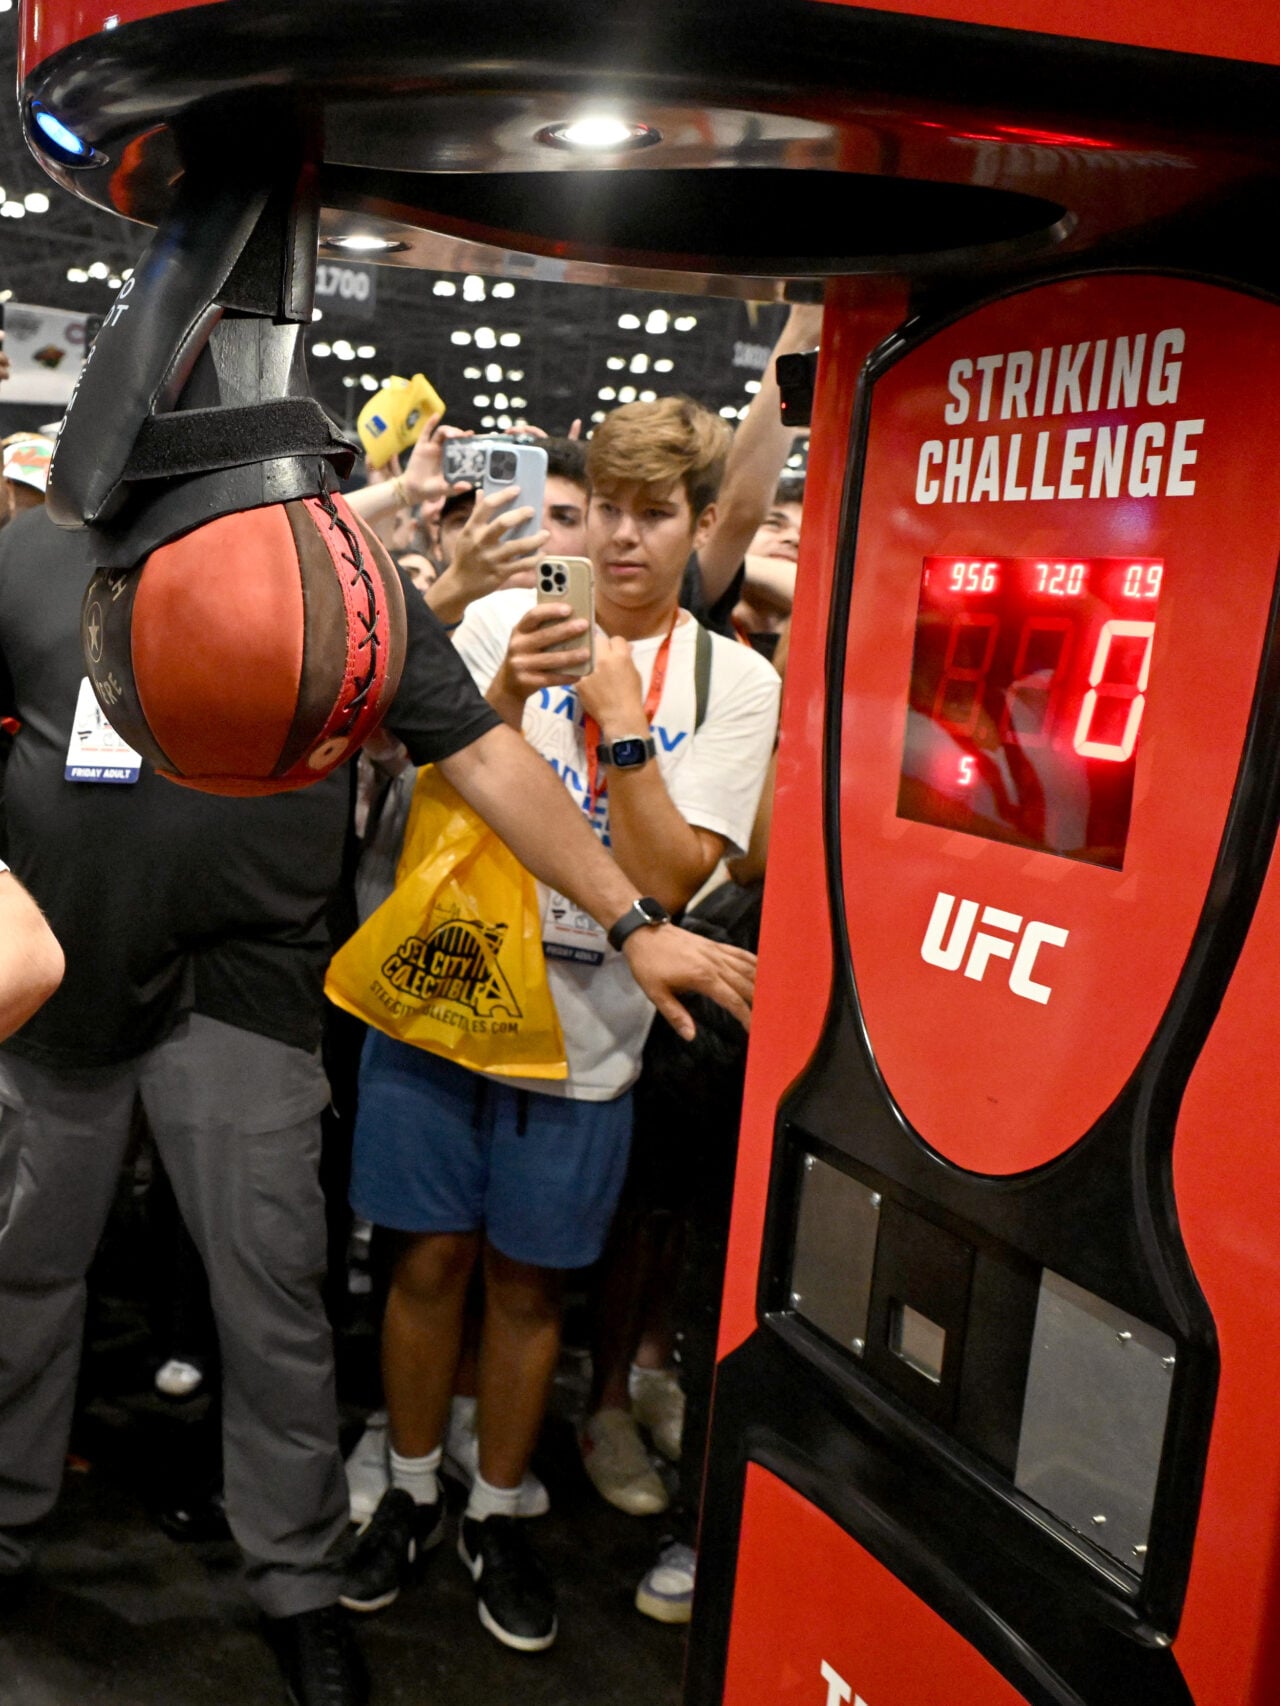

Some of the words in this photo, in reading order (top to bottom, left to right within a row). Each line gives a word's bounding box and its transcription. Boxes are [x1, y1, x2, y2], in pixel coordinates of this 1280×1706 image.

[315, 264, 371, 302] 1700
[944, 327, 1186, 426] STRIKING
[915, 418, 1206, 505] CHALLENGE
[949, 562, 999, 593] 956
[1035, 564, 1086, 596] 72.0
[1123, 565, 1164, 598] 0.9
[1073, 618, 1156, 763] 0
[71, 767, 102, 778] FRIDAY
[103, 768, 131, 780] ADULT
[957, 756, 975, 785] 5
[430, 951, 473, 978] CITY
[921, 892, 1070, 1006] UFC
